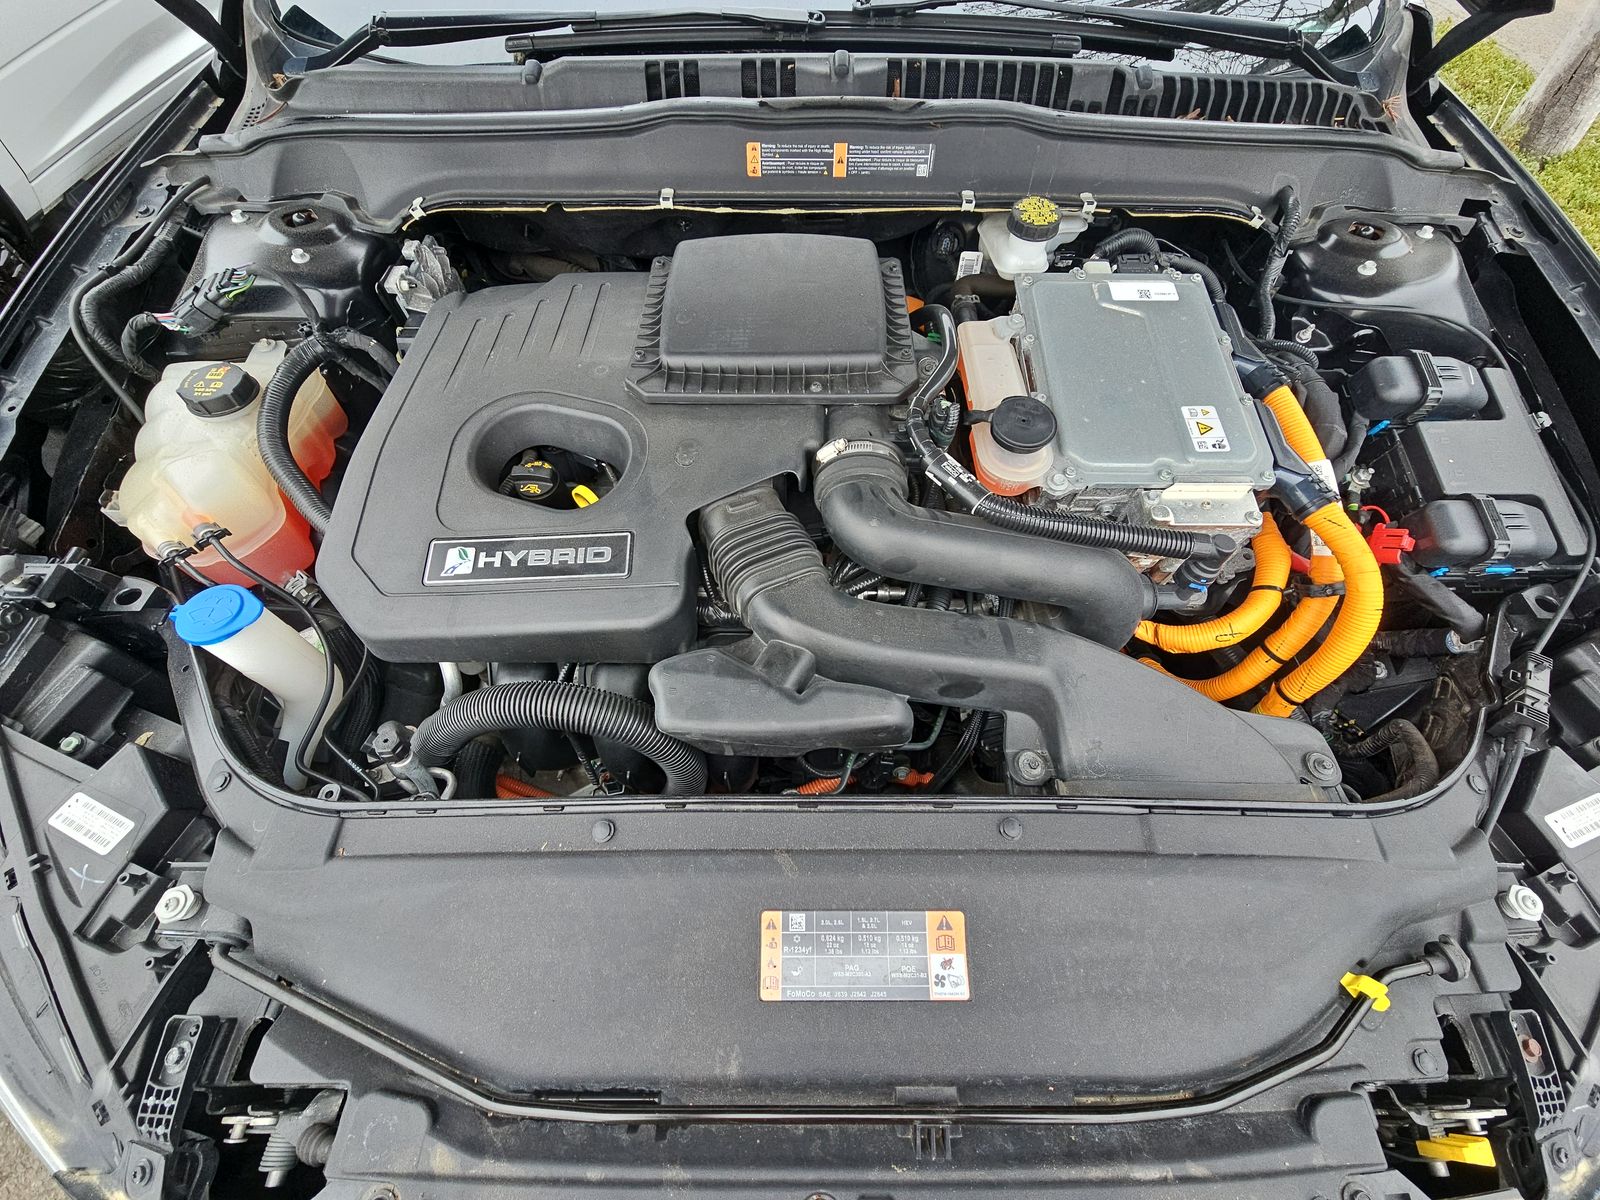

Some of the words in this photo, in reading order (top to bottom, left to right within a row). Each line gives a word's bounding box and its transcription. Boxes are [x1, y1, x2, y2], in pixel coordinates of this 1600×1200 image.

[478, 546, 612, 568] HYBRID
[836, 935, 844, 944] kg
[874, 935, 882, 943] kg
[912, 935, 919, 943] kg
[784, 946, 812, 954] R-1234yf
